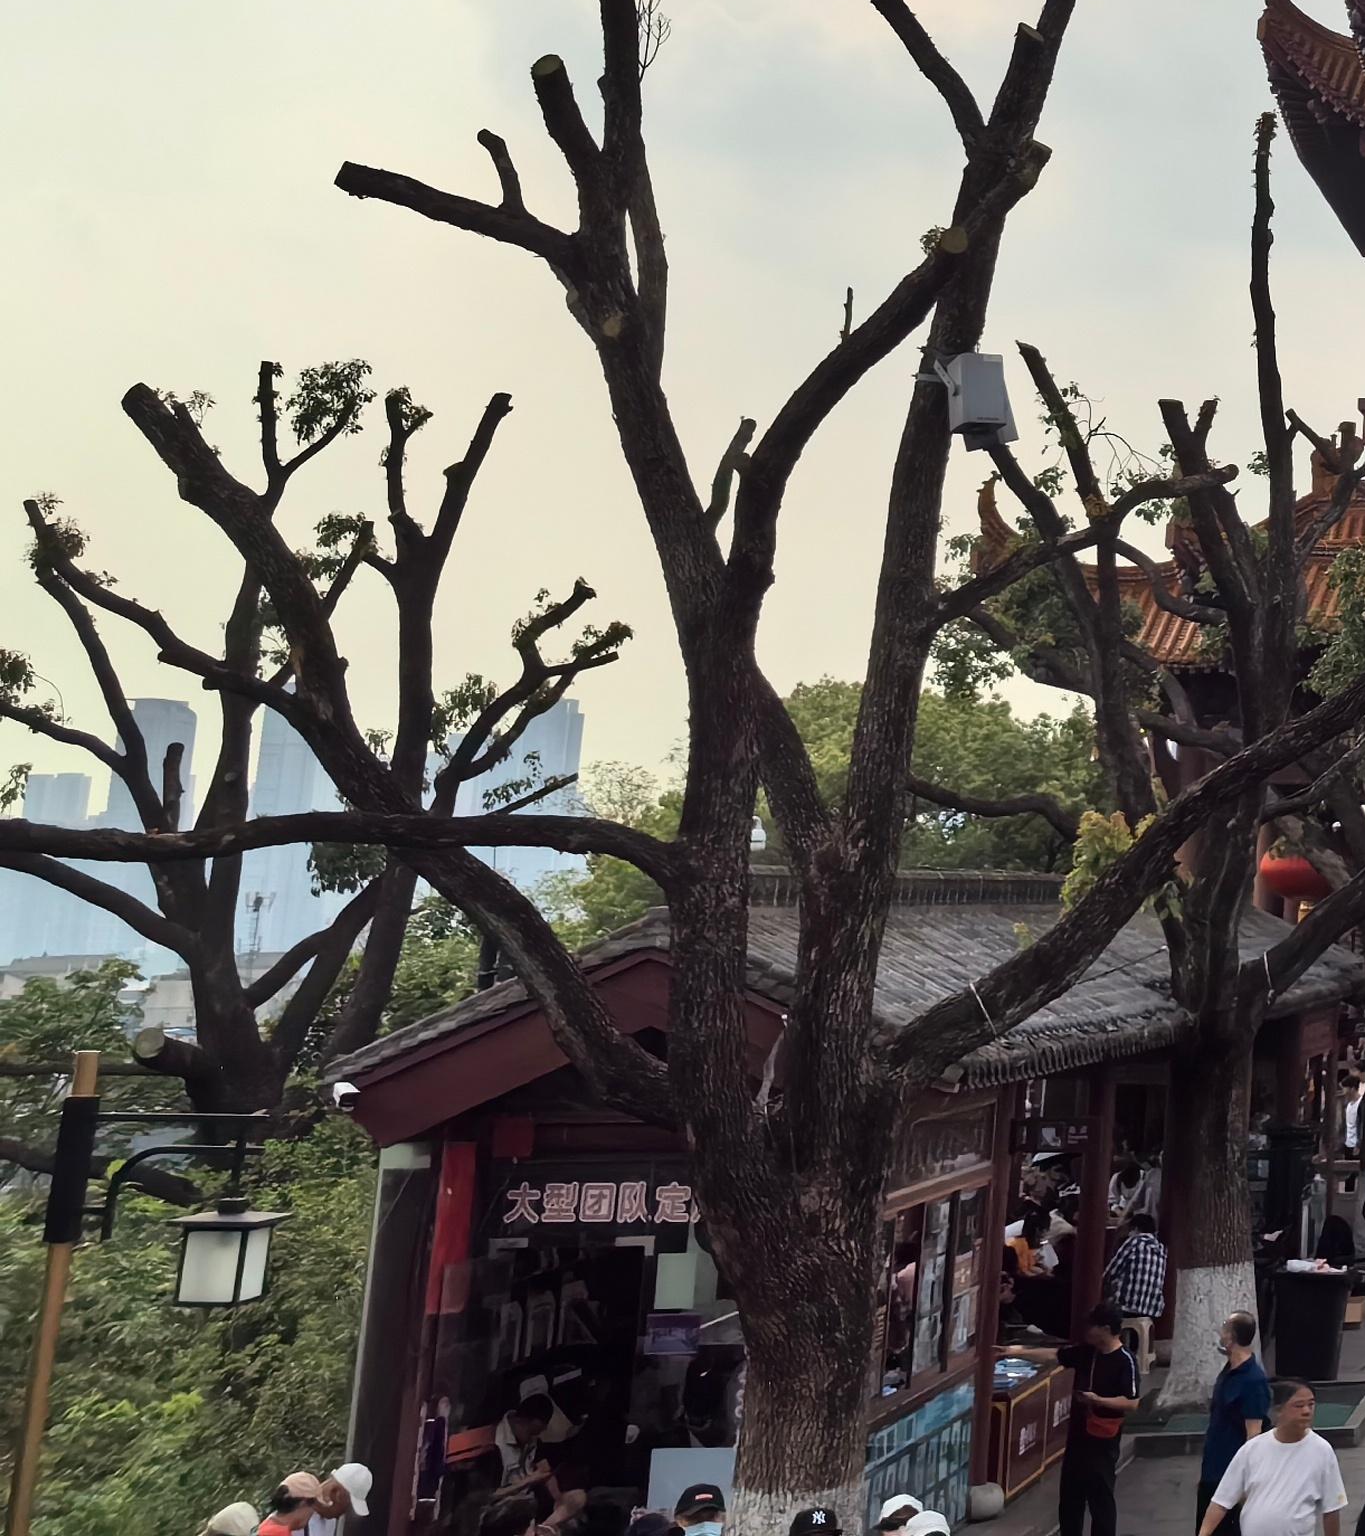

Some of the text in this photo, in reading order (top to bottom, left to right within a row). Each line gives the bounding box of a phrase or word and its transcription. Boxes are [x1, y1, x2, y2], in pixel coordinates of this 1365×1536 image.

[503, 1181, 702, 1224] 大型团队定
